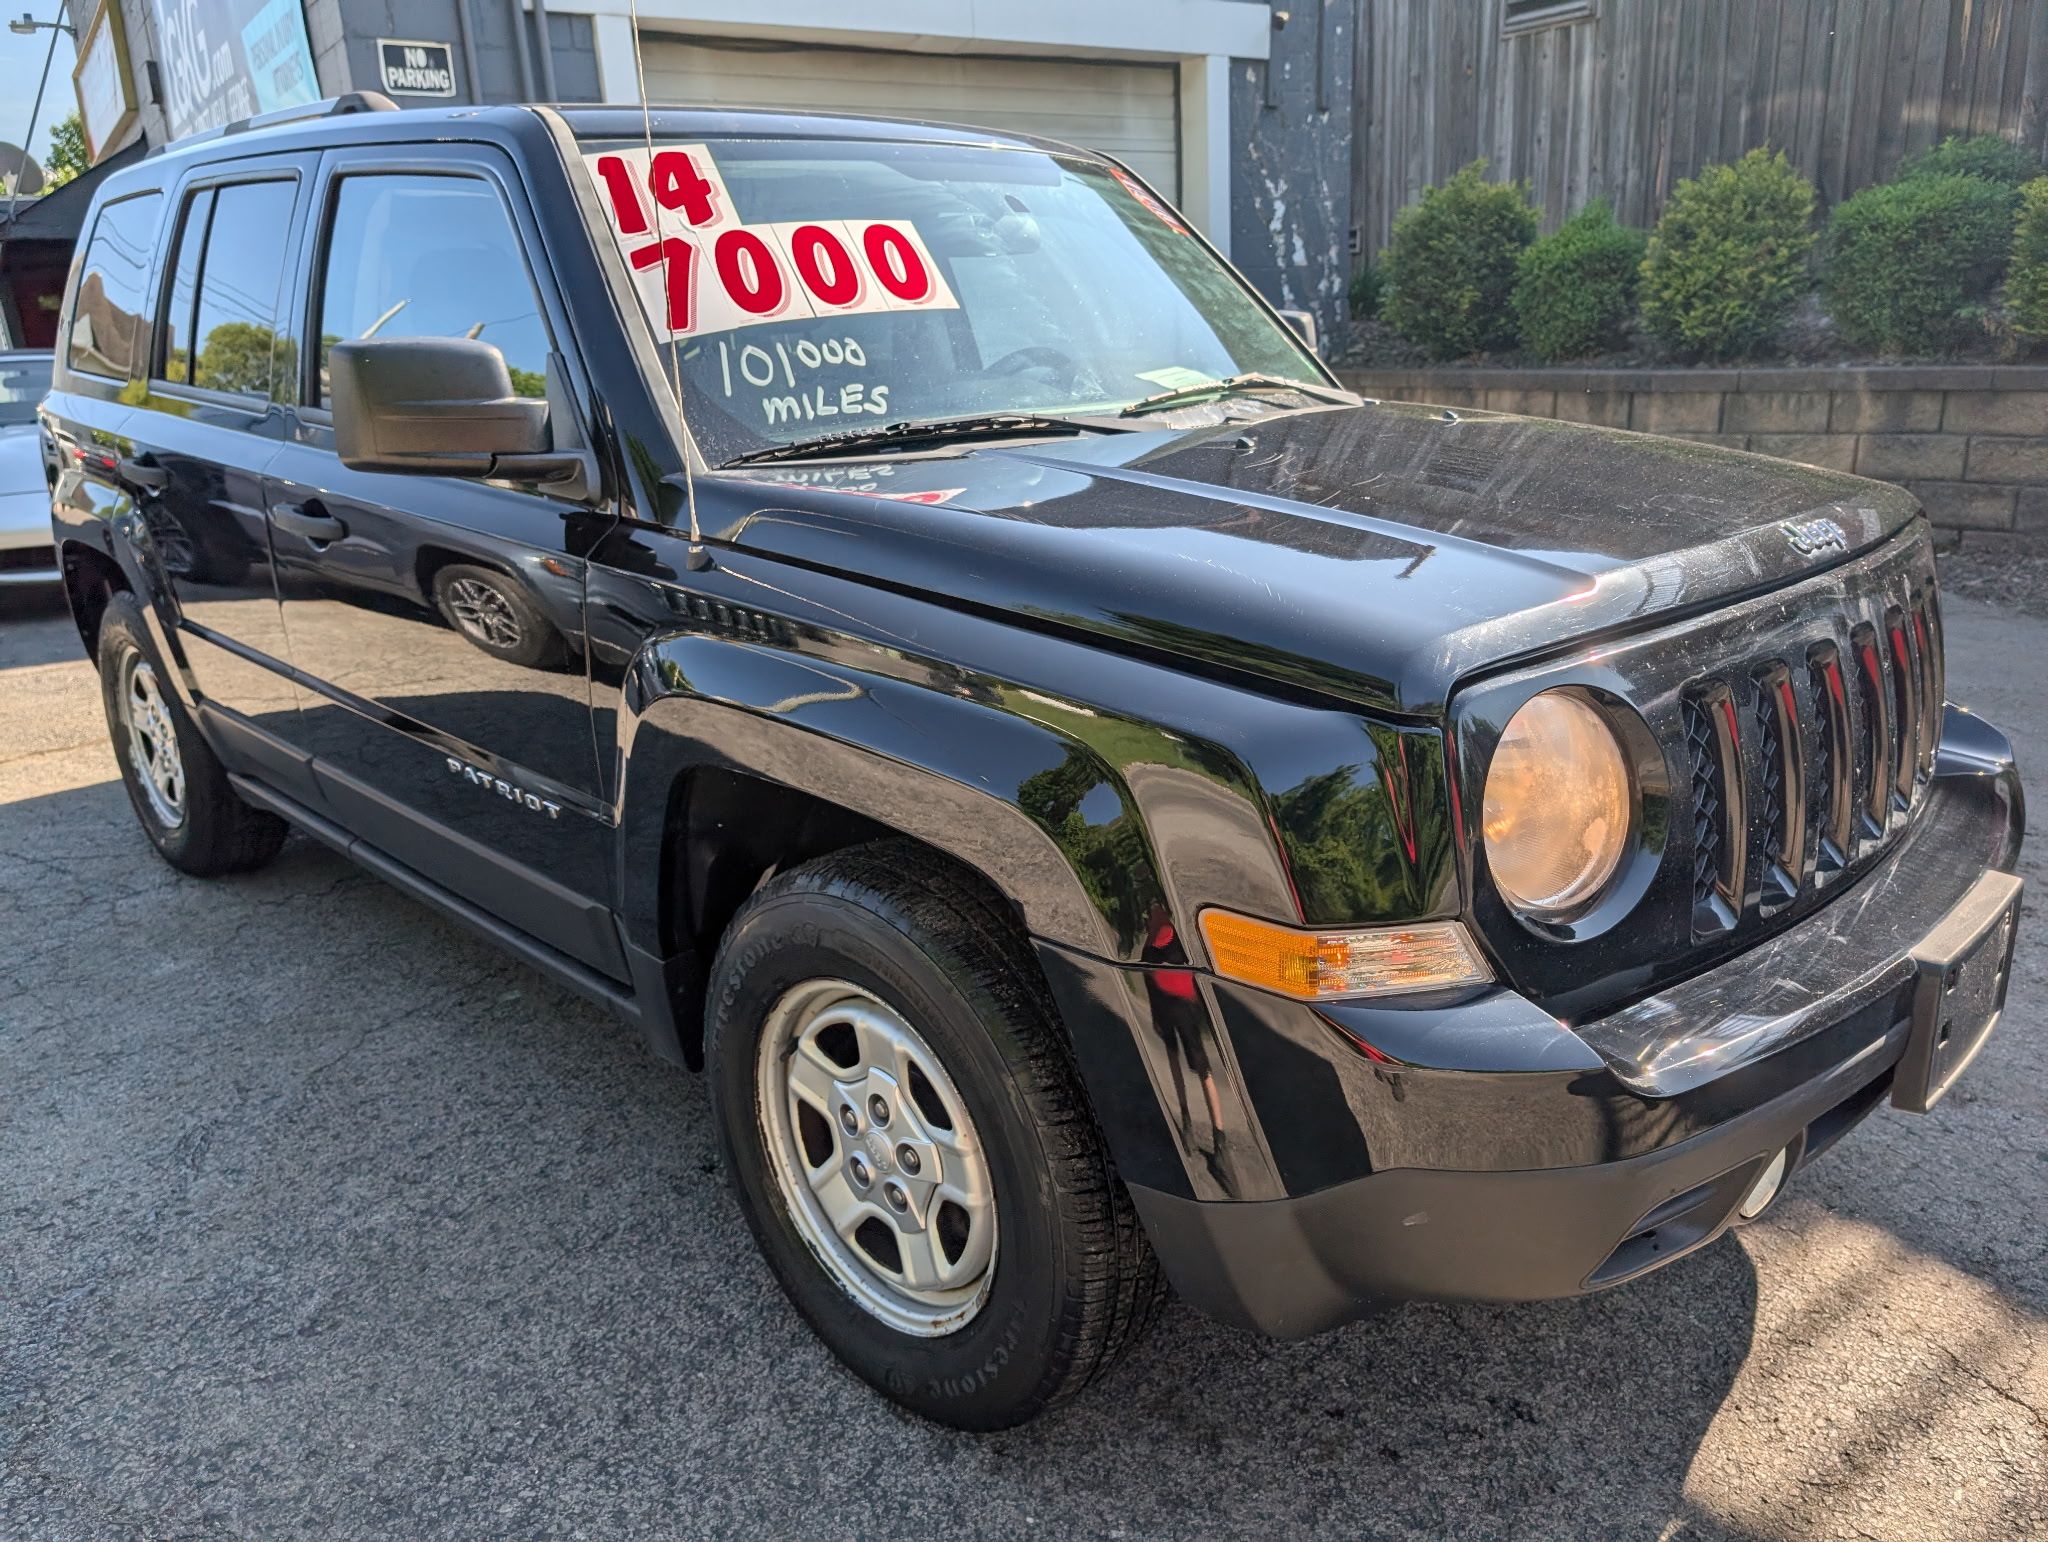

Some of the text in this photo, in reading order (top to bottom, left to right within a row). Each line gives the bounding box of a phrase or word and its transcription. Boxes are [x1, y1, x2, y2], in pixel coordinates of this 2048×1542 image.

[387, 67, 451, 90] PARKING
[404, 47, 428, 69] NO
[597, 151, 718, 235] 14
[629, 223, 934, 332] 7000
[762, 383, 889, 425] MILES
[446, 757, 562, 820] PATRIOT
